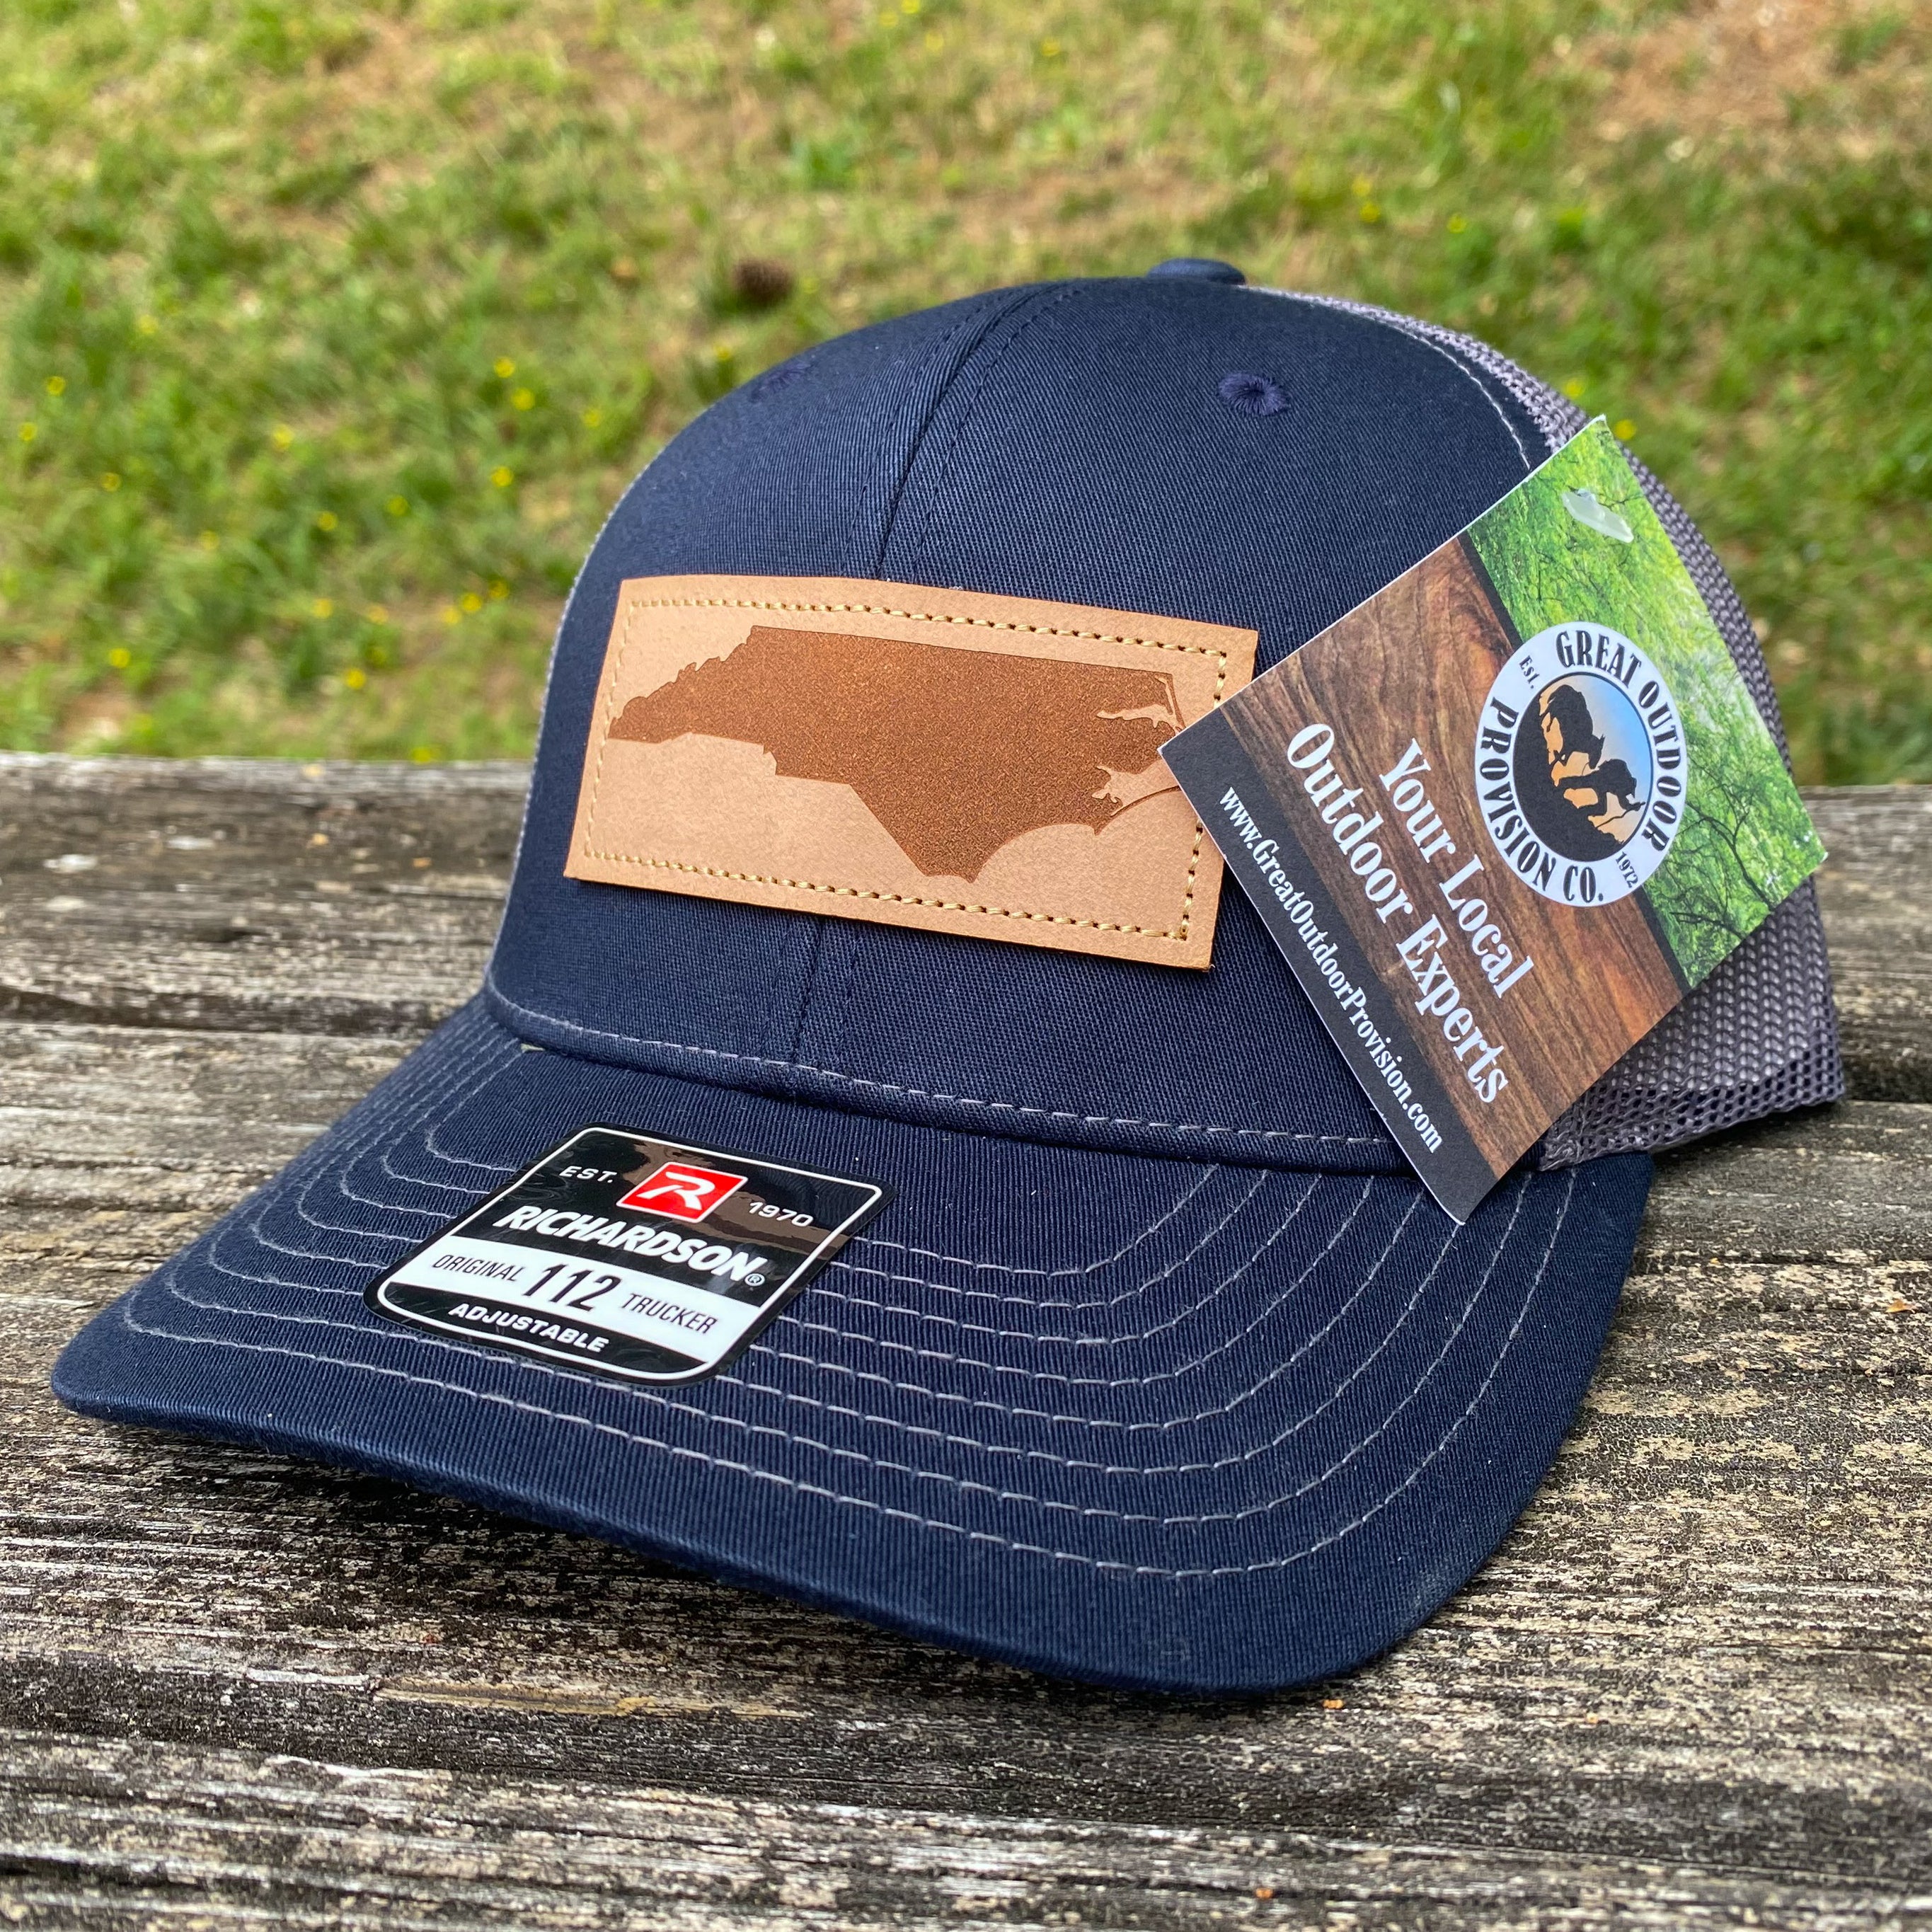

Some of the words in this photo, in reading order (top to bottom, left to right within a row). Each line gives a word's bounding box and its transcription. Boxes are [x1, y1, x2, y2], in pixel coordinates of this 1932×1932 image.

[1479, 696, 1557, 892] PROVISION
[1563, 865, 1604, 904] CO.
[1556, 630, 1642, 689] GREAT
[1638, 680, 1682, 851] OUTDOOR
[1286, 723, 1413, 924] Outdoor
[1396, 914, 1509, 1103] Experts
[1379, 737, 1457, 864] Your
[1439, 853, 1534, 999] Local
[1615, 851, 1639, 888] 1972
[1219, 786, 1444, 1154] www.GreatOutdoorProvision.com
[559, 1166, 616, 1183] EST.
[748, 1201, 813, 1227] 1970
[432, 1253, 523, 1282] ORIGINAL
[522, 1263, 623, 1312] 112
[622, 1294, 718, 1334] TRUCKER
[448, 1302, 609, 1352] ADJUSTABLE
